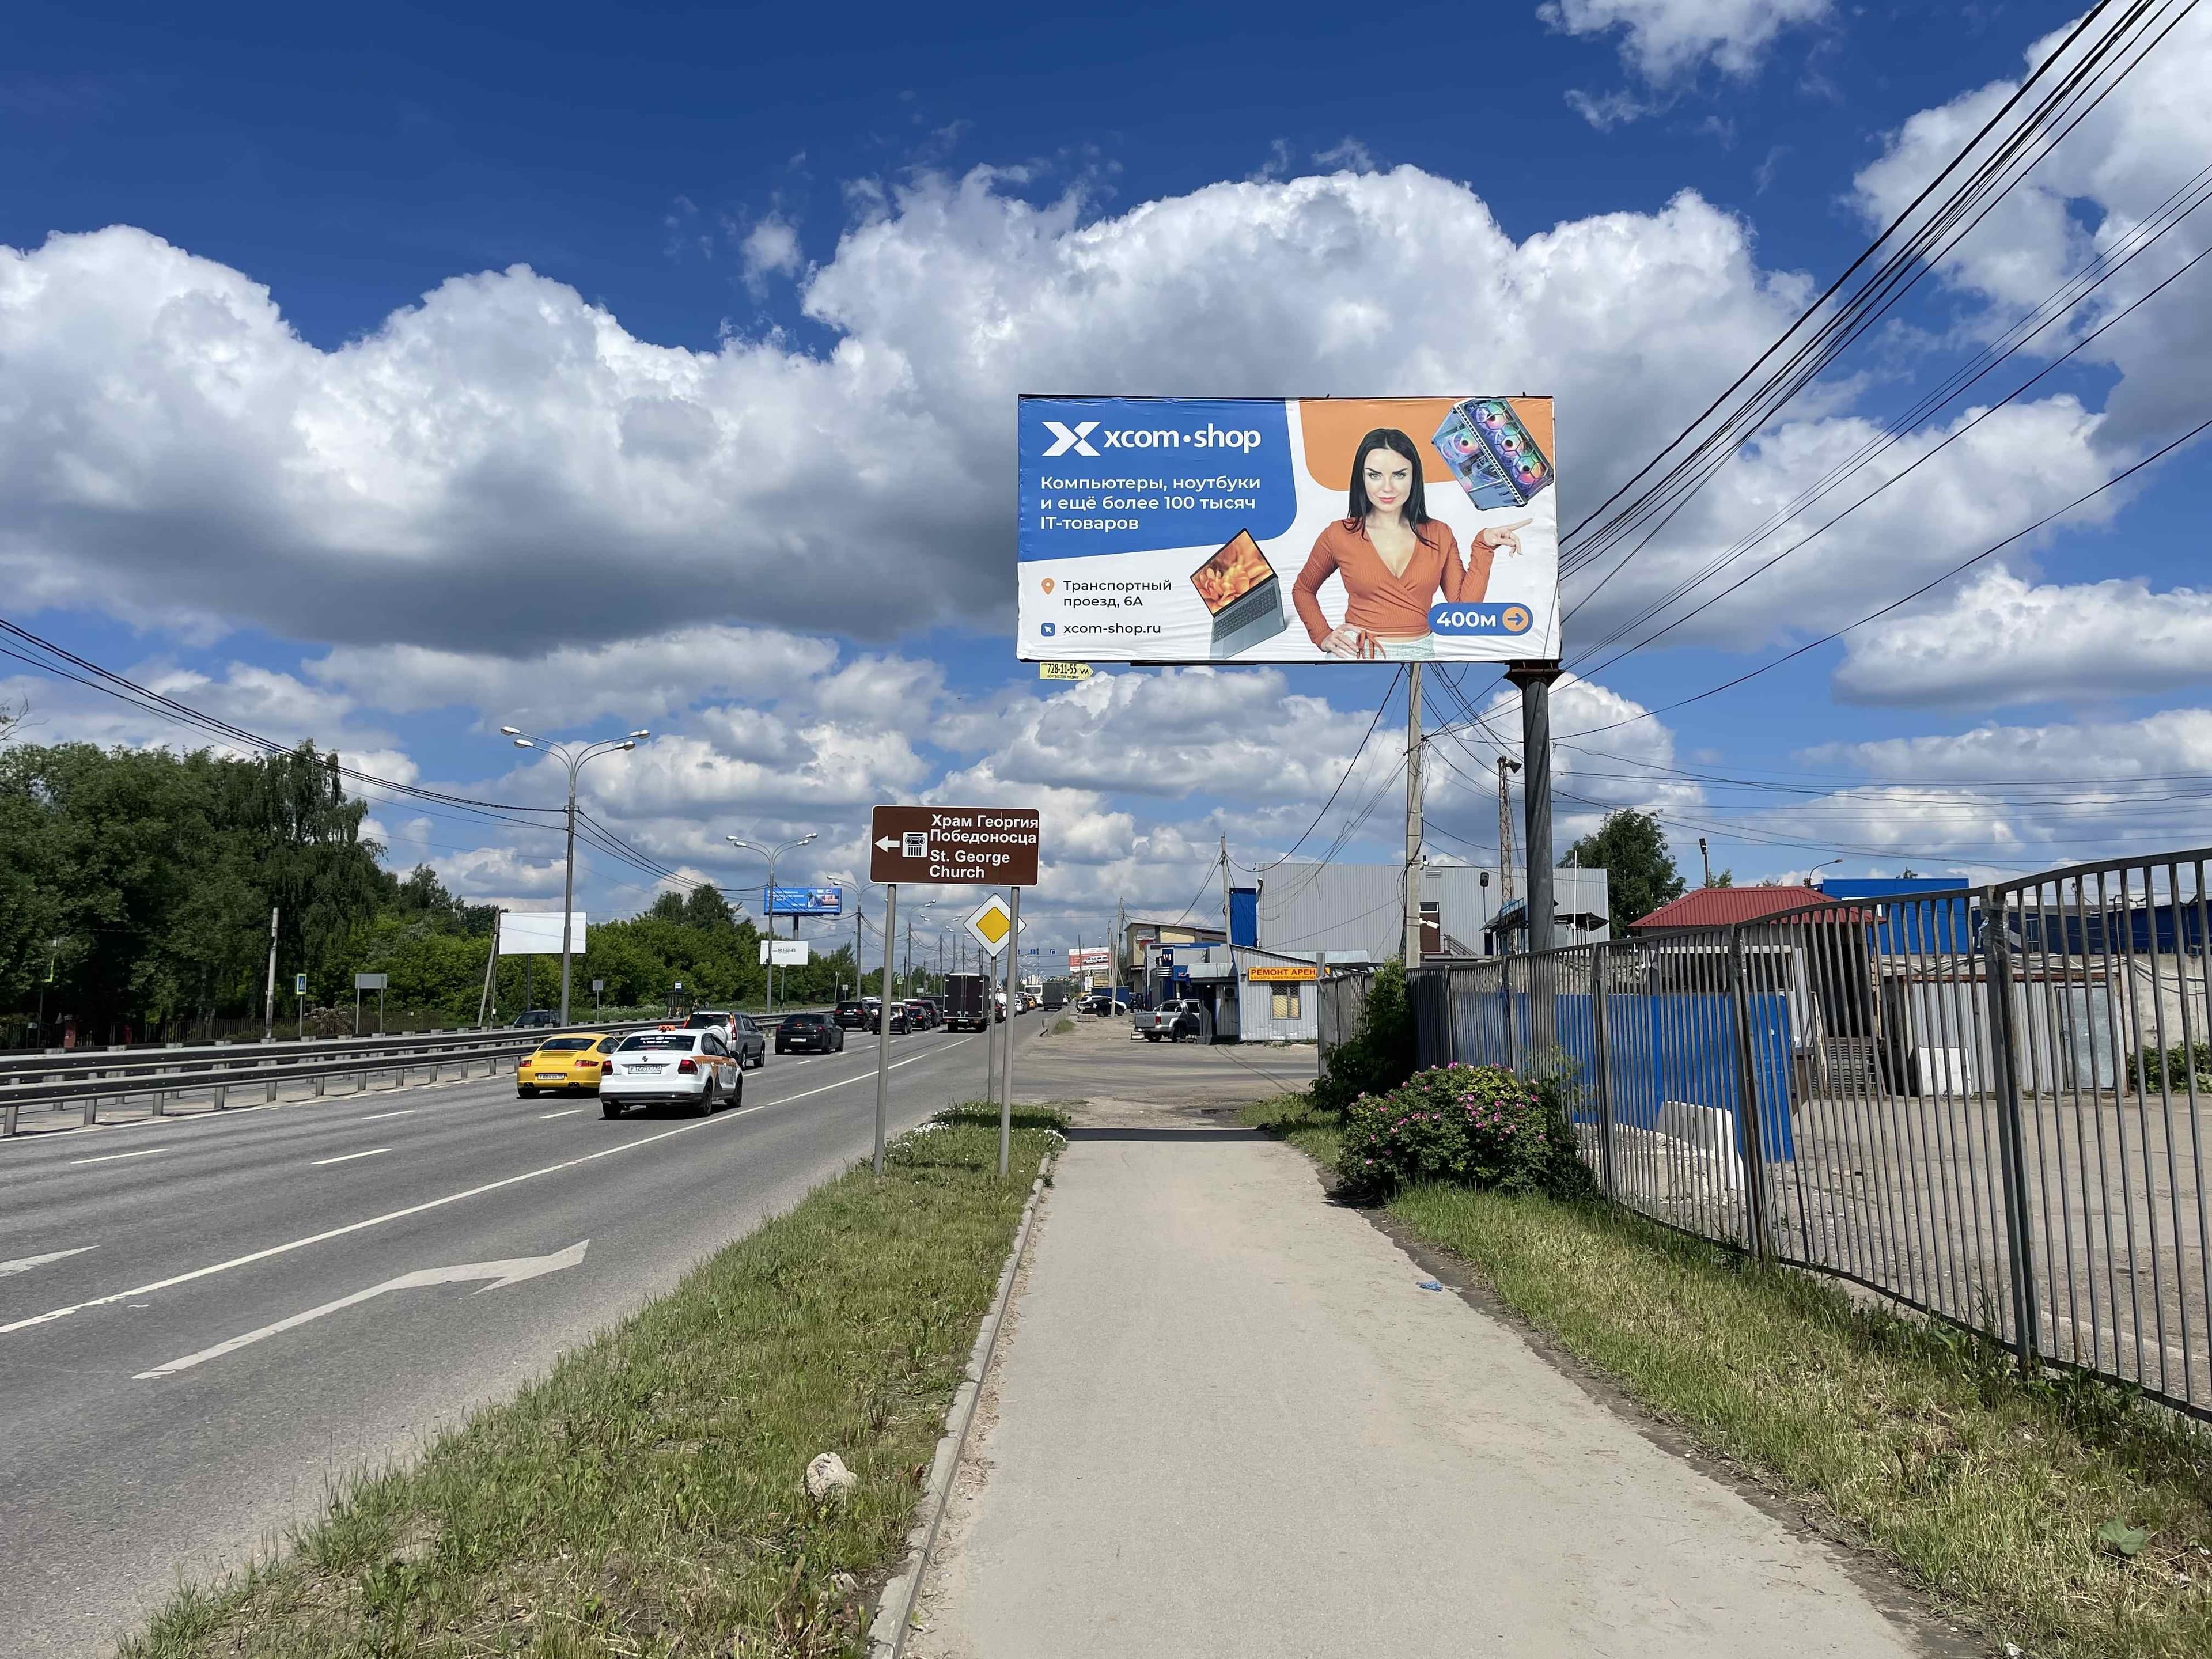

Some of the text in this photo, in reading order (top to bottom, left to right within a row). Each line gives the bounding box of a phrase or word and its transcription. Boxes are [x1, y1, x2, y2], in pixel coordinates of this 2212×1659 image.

[1041, 475, 1260, 493] Компьютеры, ноутбуки
[1041, 495, 1256, 511] и ещё более 100 тысяч
[1041, 516, 1139, 532] IT-товаров
[1063, 579, 1172, 593] Транспортный
[1063, 596, 1143, 608] проезд, 6А
[1063, 623, 1161, 636] xcom-shop.ru
[1047, 663, 1077, 674] 728-11-55
[931, 814, 1039, 831] Храм Георгия
[930, 829, 1037, 845] Победоносца
[930, 850, 1010, 866] St. George
[929, 865, 985, 878] Church
